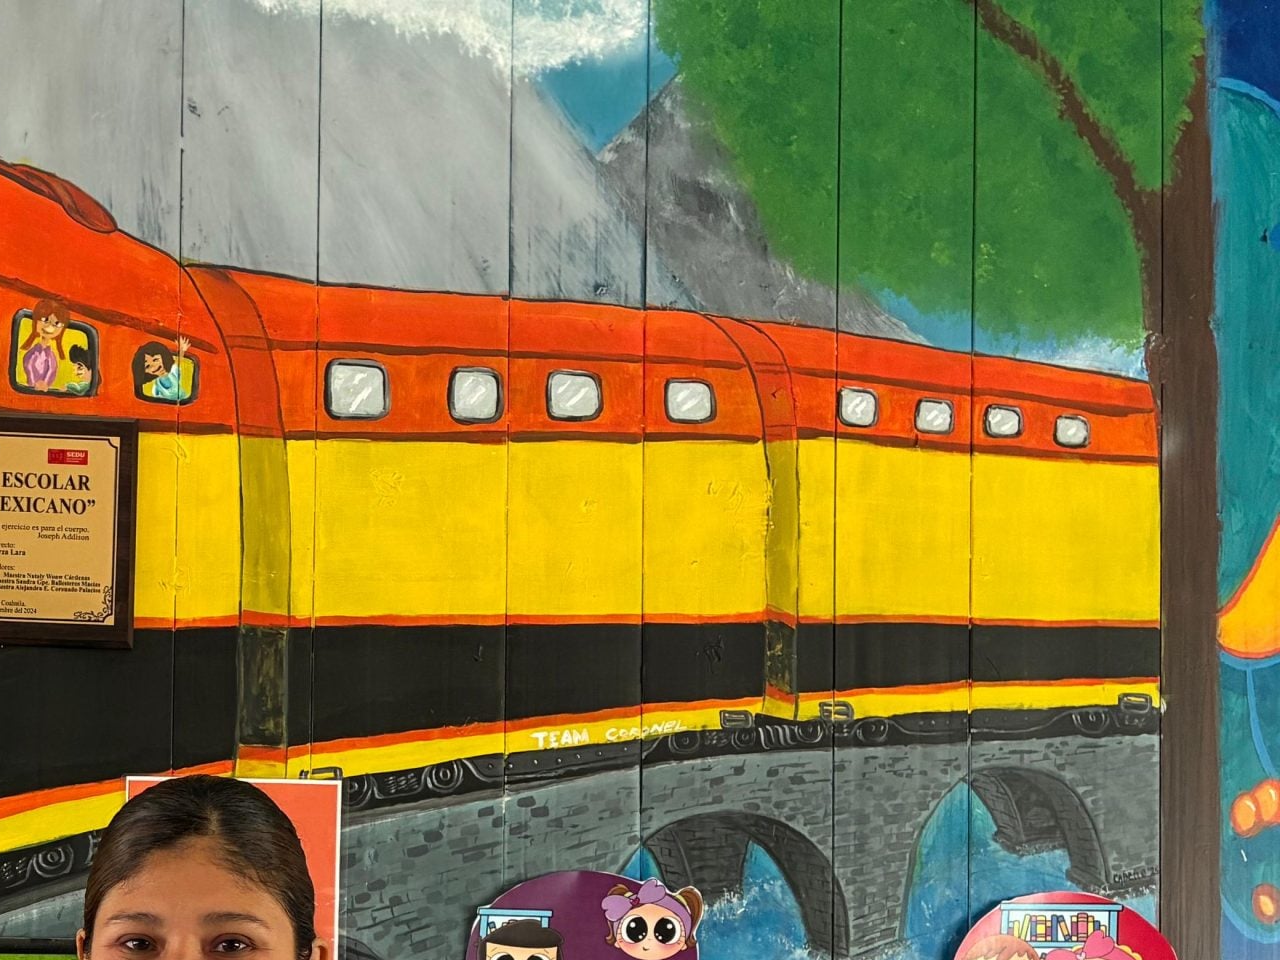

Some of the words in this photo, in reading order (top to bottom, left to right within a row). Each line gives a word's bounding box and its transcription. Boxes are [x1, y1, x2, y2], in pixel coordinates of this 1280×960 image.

[2, 471, 91, 491] ESCOLAR
[1, 523, 31, 531] ejercicio
[40, 525, 56, 533] para
[57, 524, 64, 532] el
[37, 532, 60, 541] Joseph
[61, 533, 90, 541] Addison
[10, 548, 26, 556] Lara
[530, 728, 590, 749] TEAM
[605, 720, 688, 742] CORONEL
